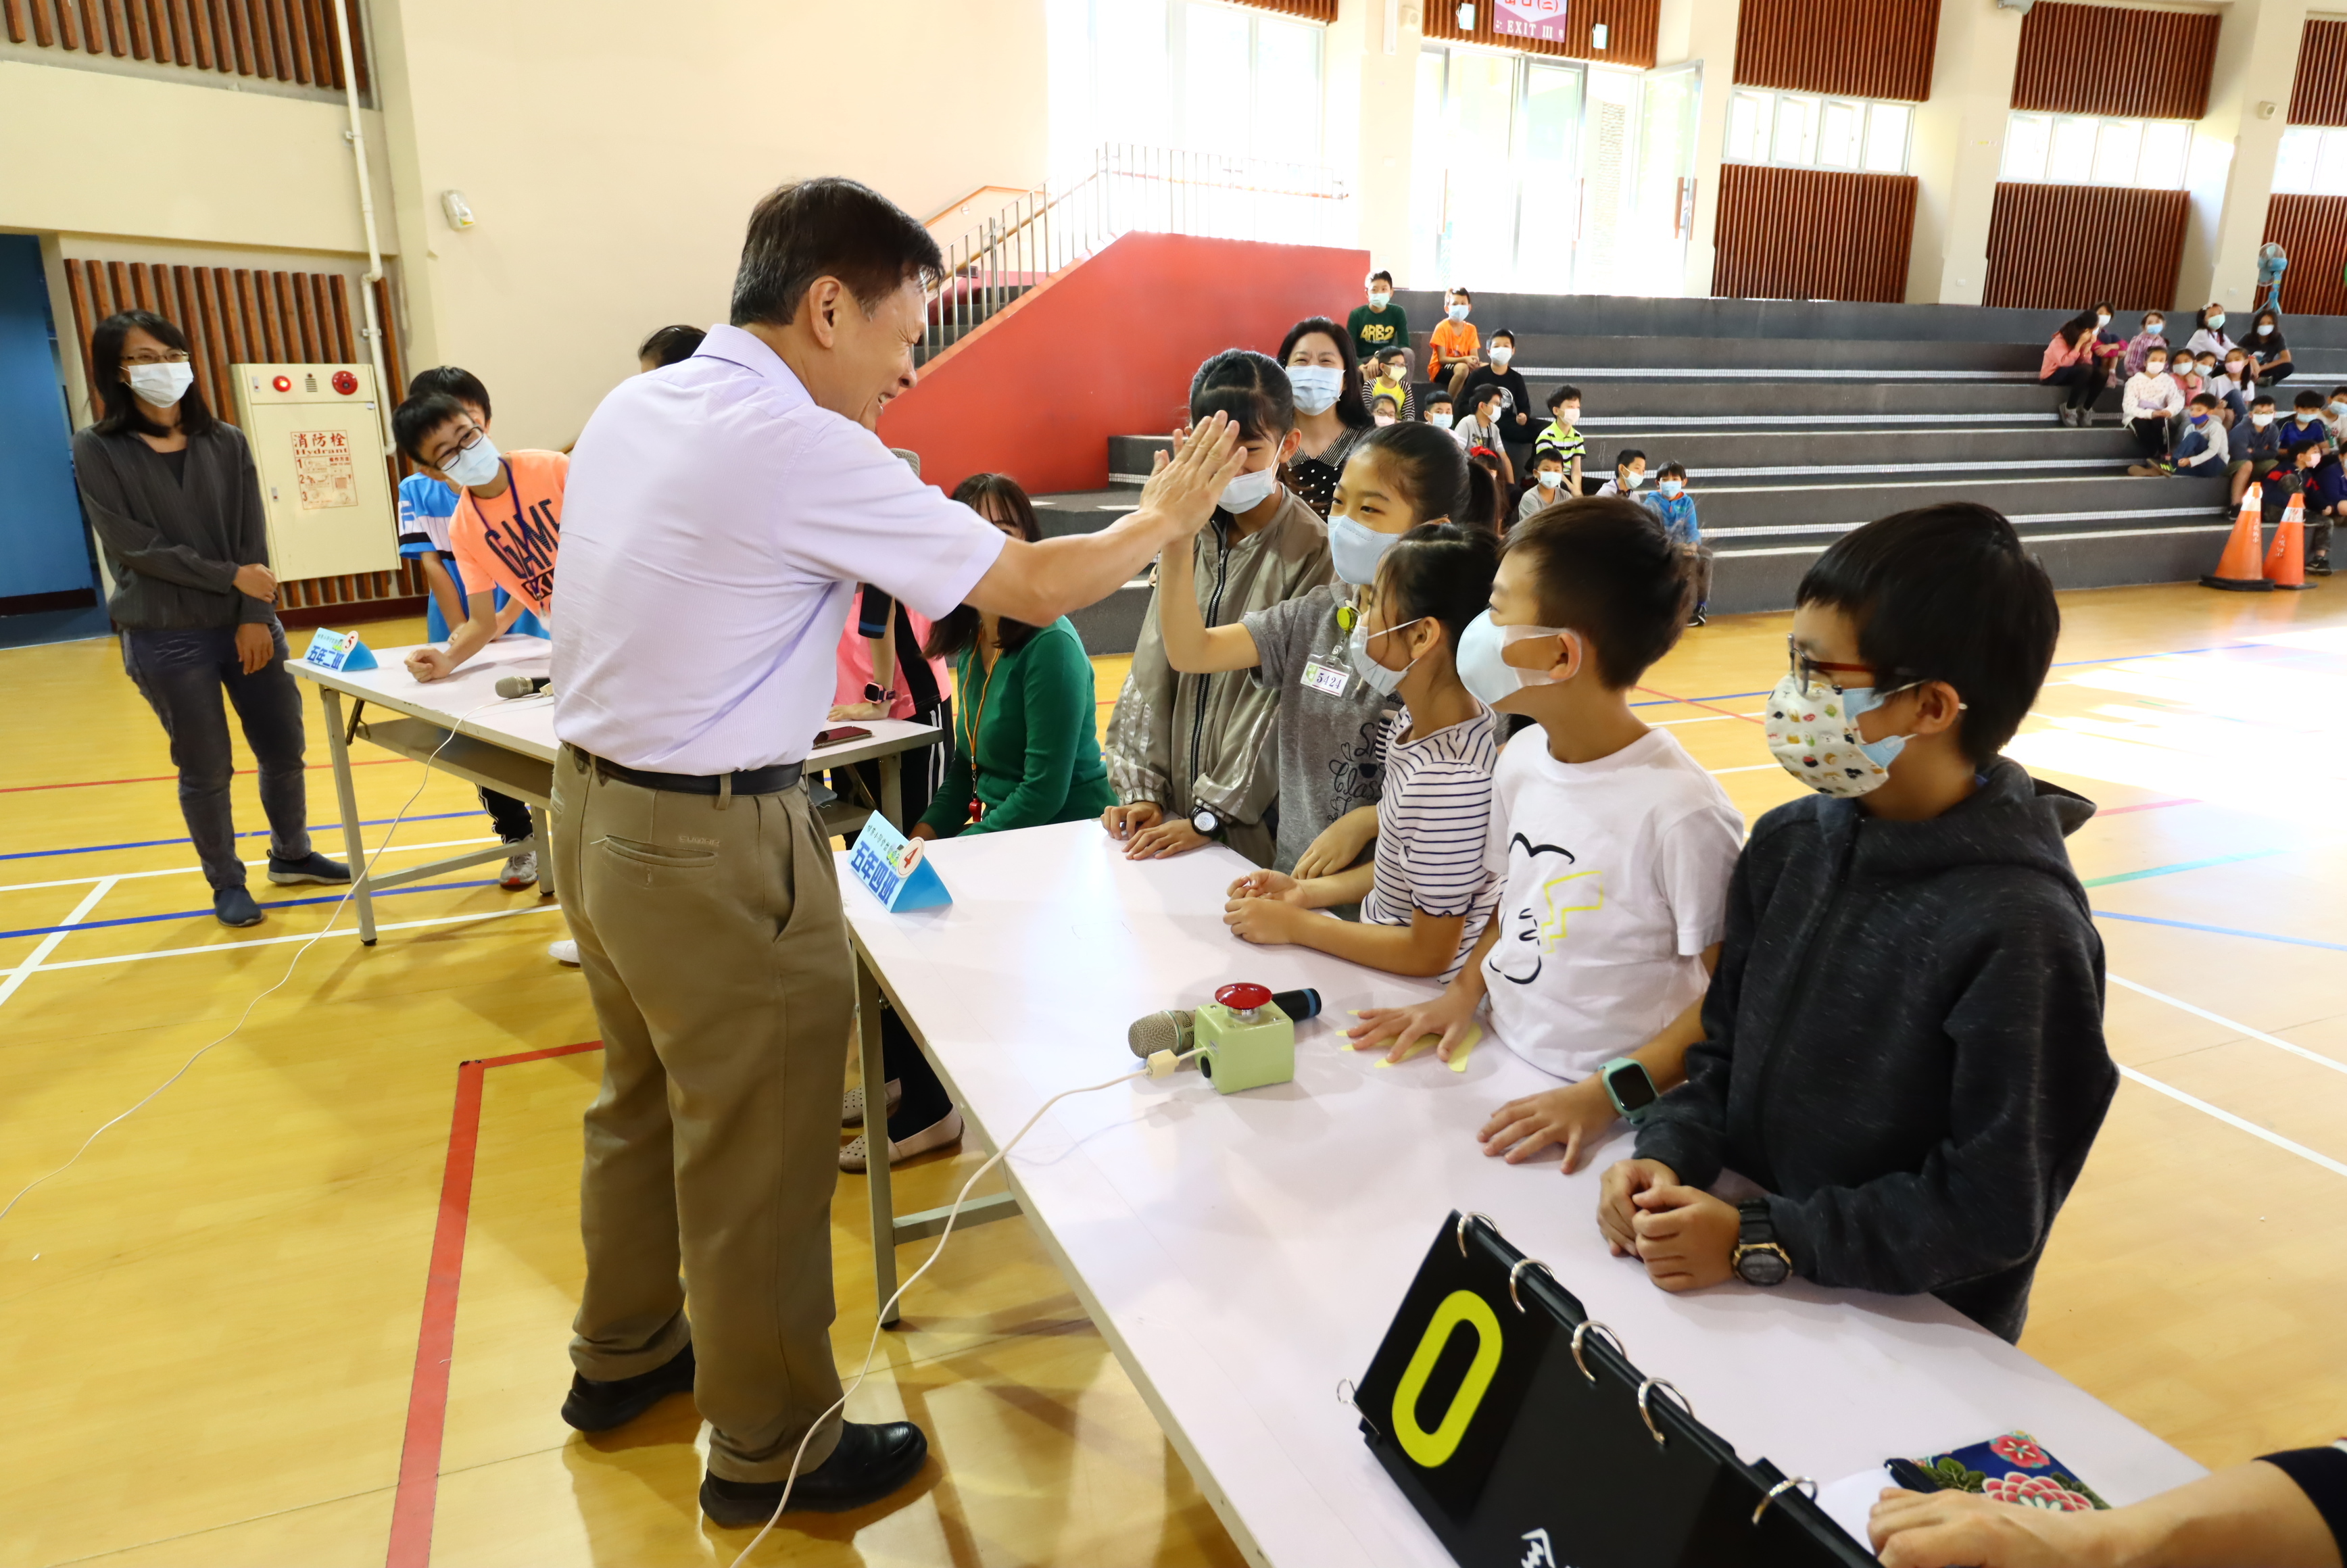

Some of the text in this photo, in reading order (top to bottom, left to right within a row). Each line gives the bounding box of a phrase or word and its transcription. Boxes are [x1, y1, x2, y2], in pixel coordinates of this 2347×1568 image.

[1507, 20, 1537, 36] EXIT
[293, 433, 346, 448] 消防栓
[296, 448, 347, 456] Hydrant
[297, 459, 303, 468] 1
[299, 474, 305, 484] 2
[302, 491, 308, 501] 3
[345, 636, 355, 649] 5
[1317, 672, 1342, 689] 5424
[904, 847, 919, 869] 4
[850, 840, 900, 906] 五年四班
[1391, 1290, 1503, 1468] 0
